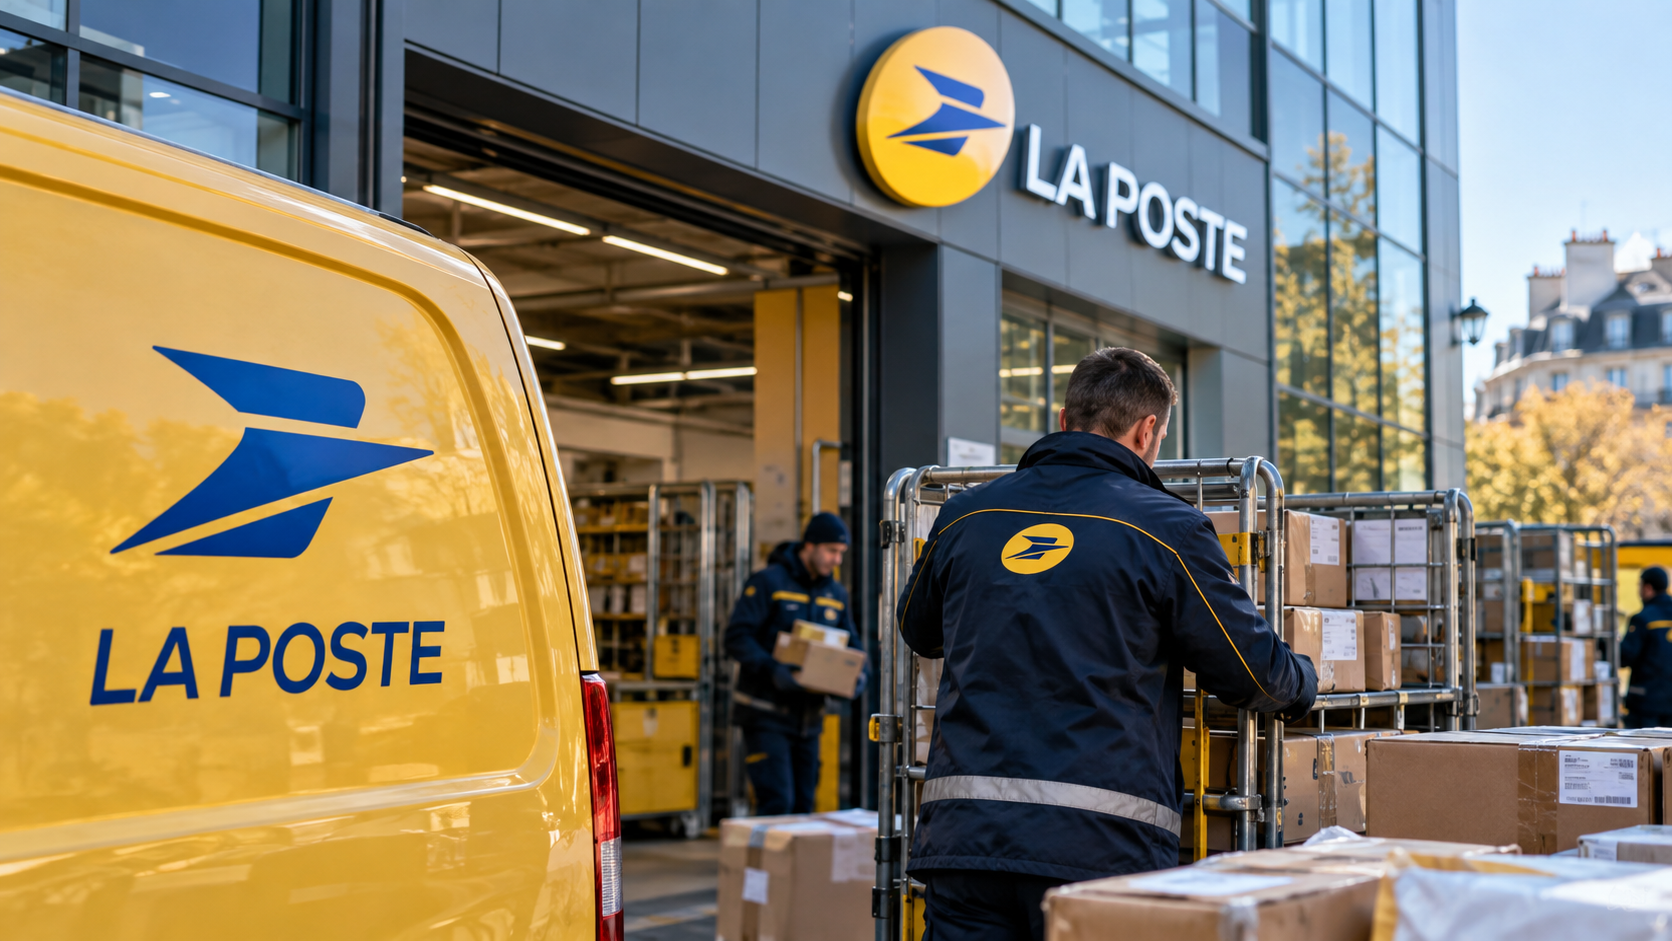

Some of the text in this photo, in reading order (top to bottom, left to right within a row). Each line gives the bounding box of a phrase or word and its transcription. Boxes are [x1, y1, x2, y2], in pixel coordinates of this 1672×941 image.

[1026, 123, 1248, 285] LA POSTE
[90, 621, 445, 706] LA POSTE
